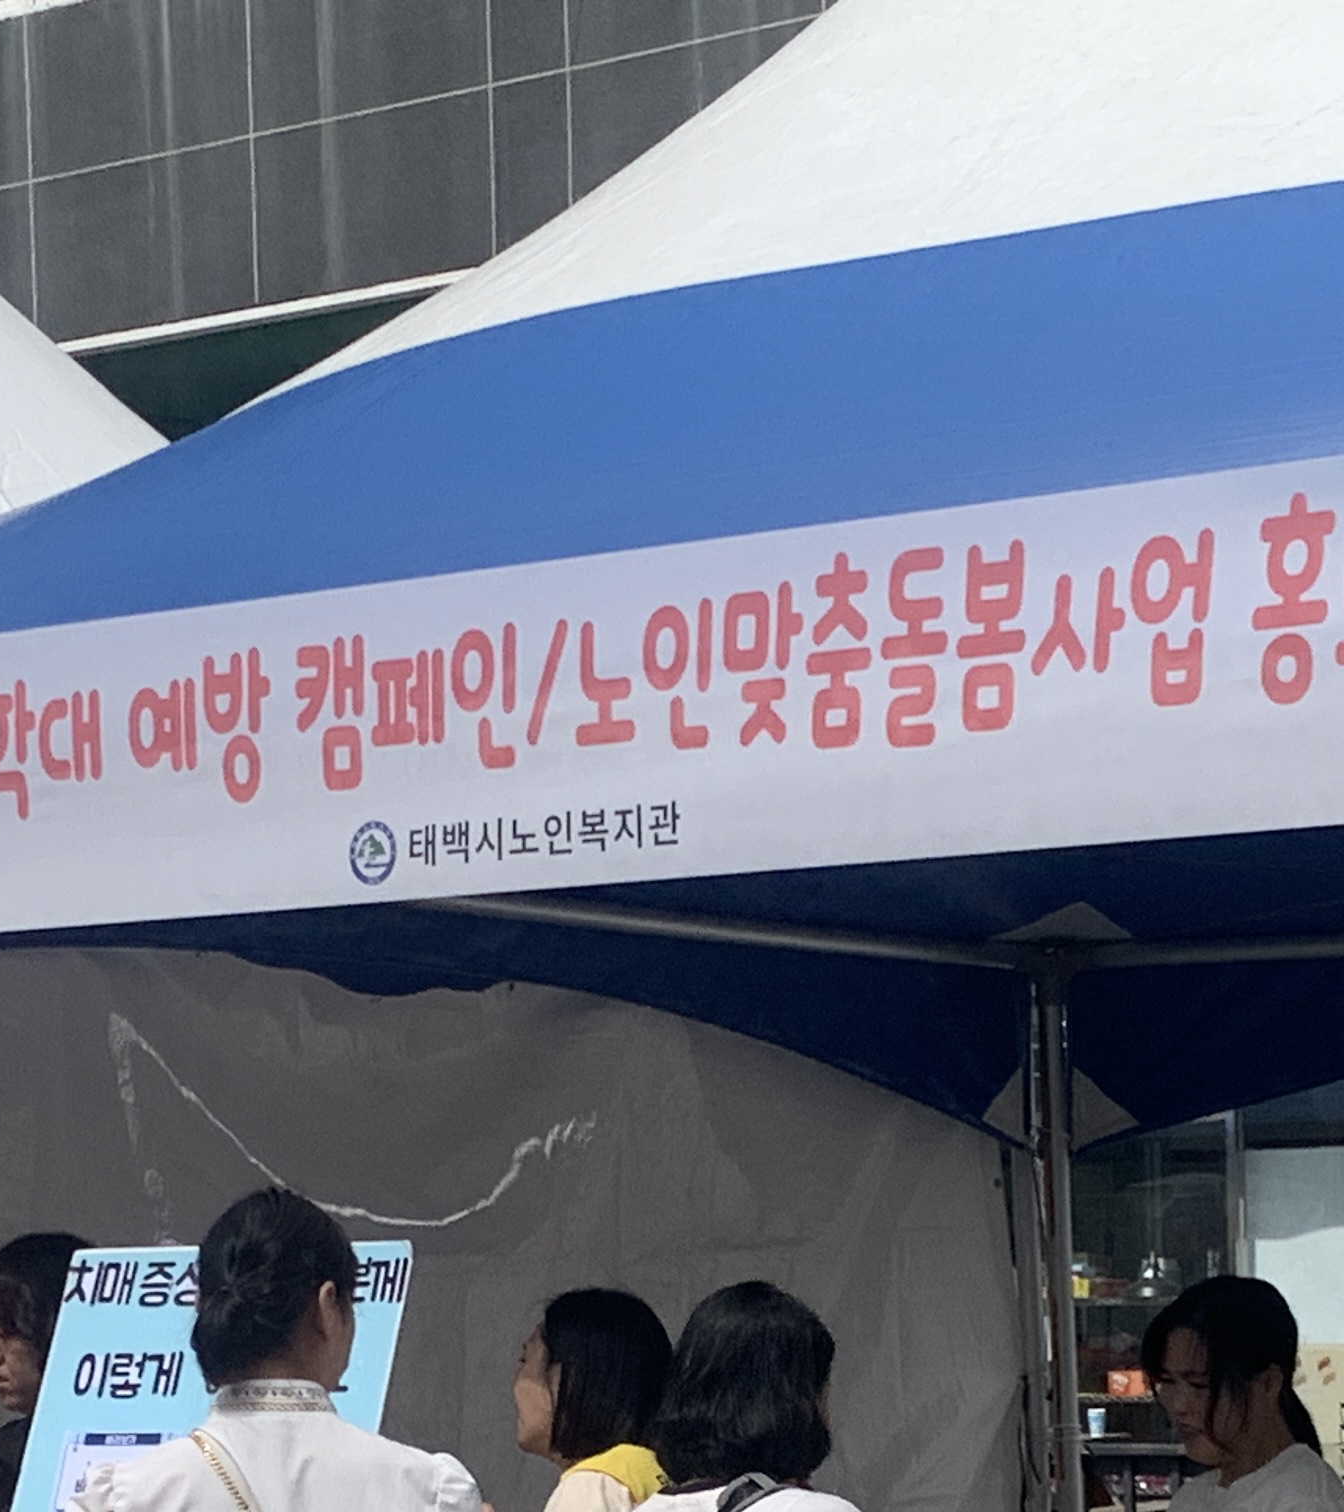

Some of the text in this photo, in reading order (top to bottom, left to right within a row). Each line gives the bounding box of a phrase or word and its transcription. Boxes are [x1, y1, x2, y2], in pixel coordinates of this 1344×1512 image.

[128, 646, 271, 804] 예방
[295, 527, 1218, 792] 캠페인/노인맞춤돌봄사업
[409, 800, 680, 866] 태백시노인복지관
[64, 1259, 138, 1306] 치매
[74, 1351, 184, 1399] 이렇게
